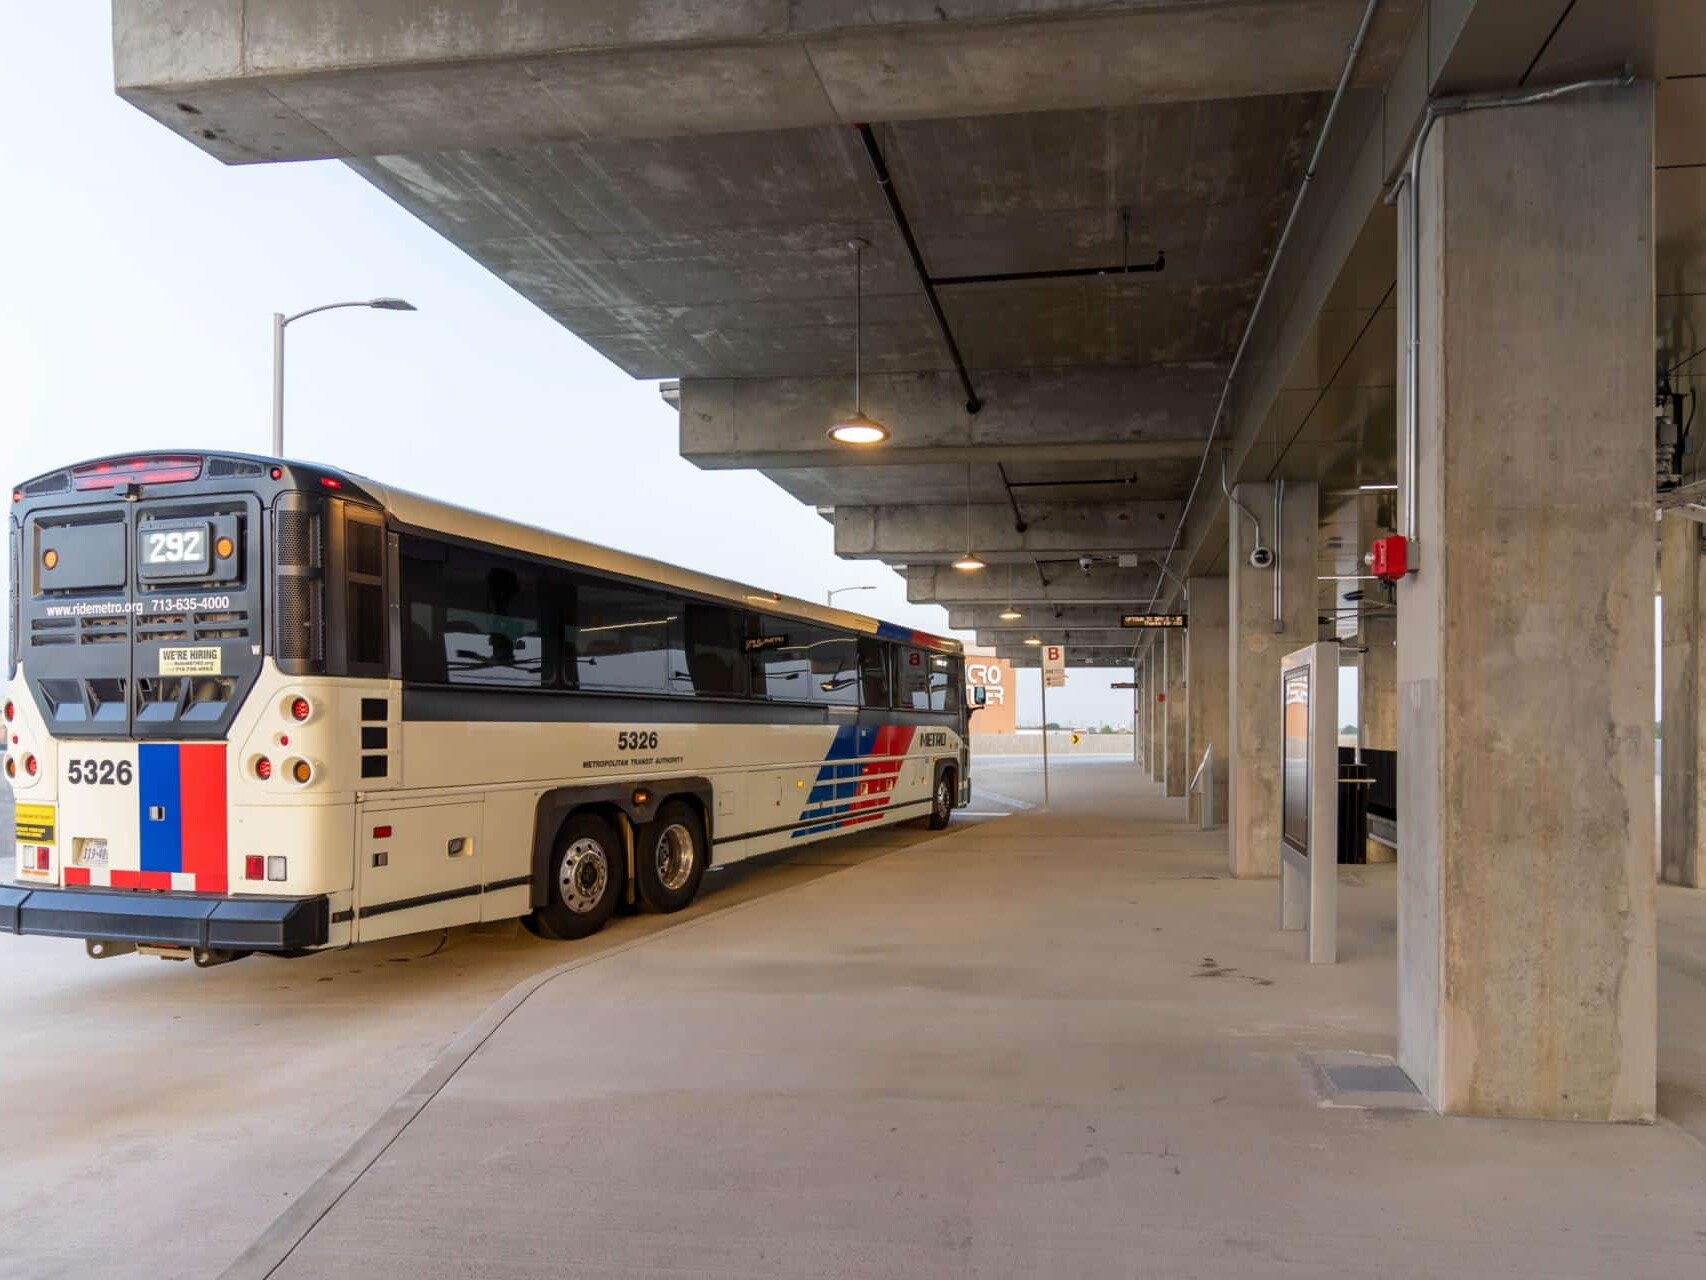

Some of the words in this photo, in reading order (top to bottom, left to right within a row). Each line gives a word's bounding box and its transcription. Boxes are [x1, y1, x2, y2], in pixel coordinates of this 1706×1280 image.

[149, 531, 200, 562] 292
[47, 601, 143, 616] www.ridemetro.org
[152, 596, 230, 612] 713-635-4000
[163, 650, 188, 660] WE'RE
[190, 649, 217, 660] HIRING
[1048, 647, 1060, 660] B
[617, 731, 659, 750] 5326
[582, 760, 629, 769] METROPOLITAN
[631, 758, 654, 766] TRANSIT
[655, 756, 684, 764] AUTHORITY
[68, 759, 133, 786] 5326
